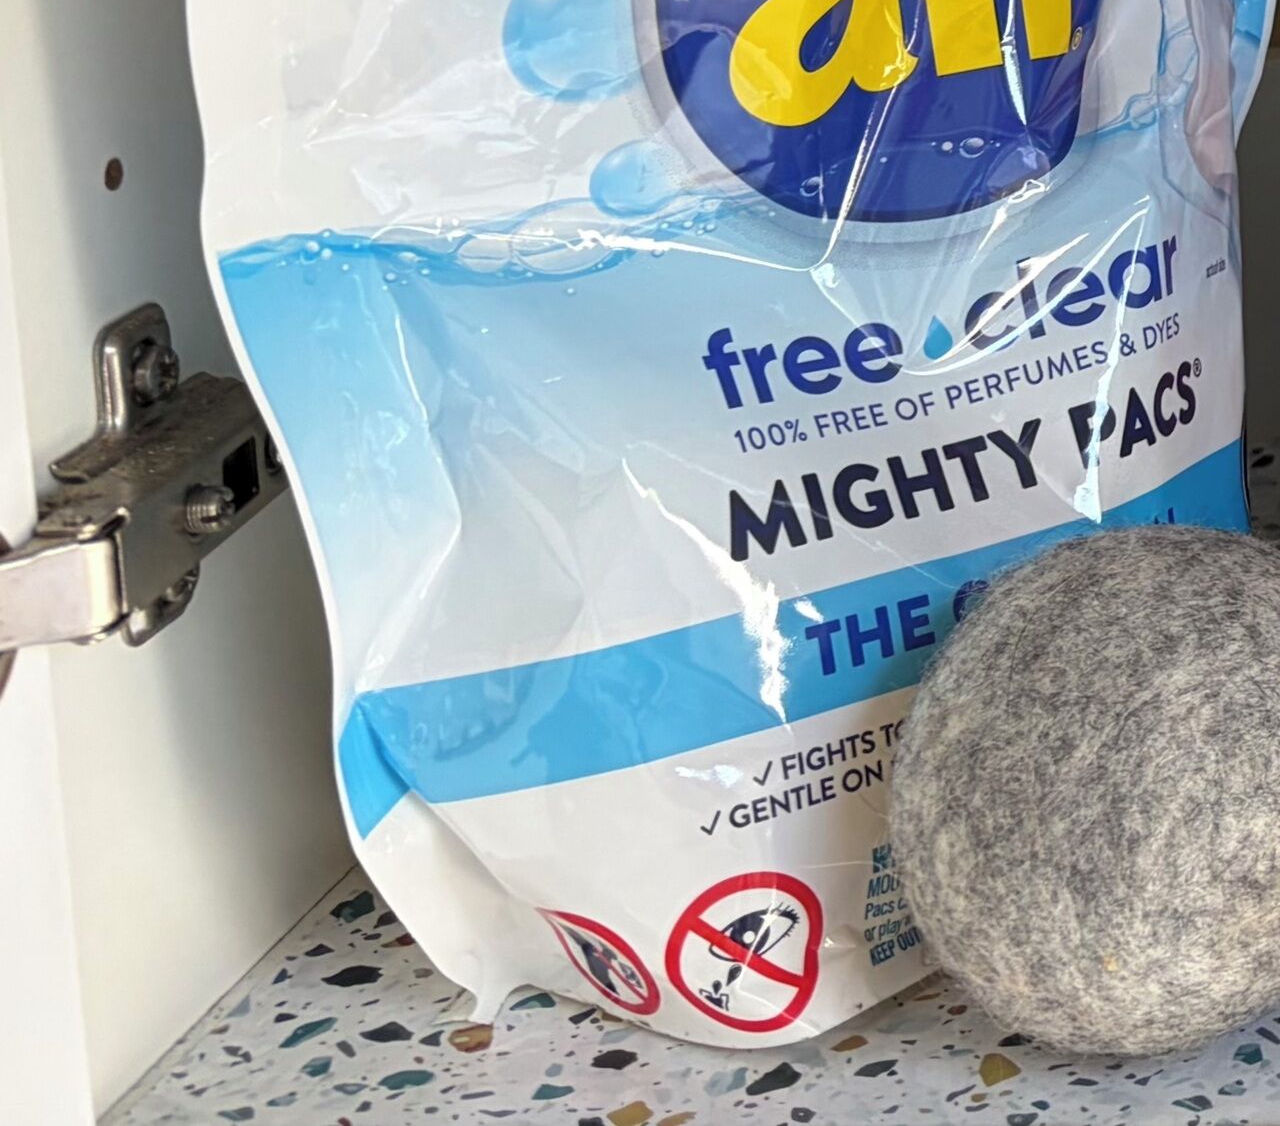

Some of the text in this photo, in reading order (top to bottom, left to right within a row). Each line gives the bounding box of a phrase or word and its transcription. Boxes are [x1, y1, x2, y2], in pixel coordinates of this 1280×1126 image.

[702, 234, 1178, 410] free clear
[734, 313, 1181, 454] 100% FREE OF PERFUMES & DYES
[729, 418, 1042, 562] MIGHTY
[804, 593, 936, 676] THE
[729, 760, 884, 829] GENTLE ON
[781, 730, 876, 780] FIGHTS
[869, 926, 922, 967] KEEP OUT
